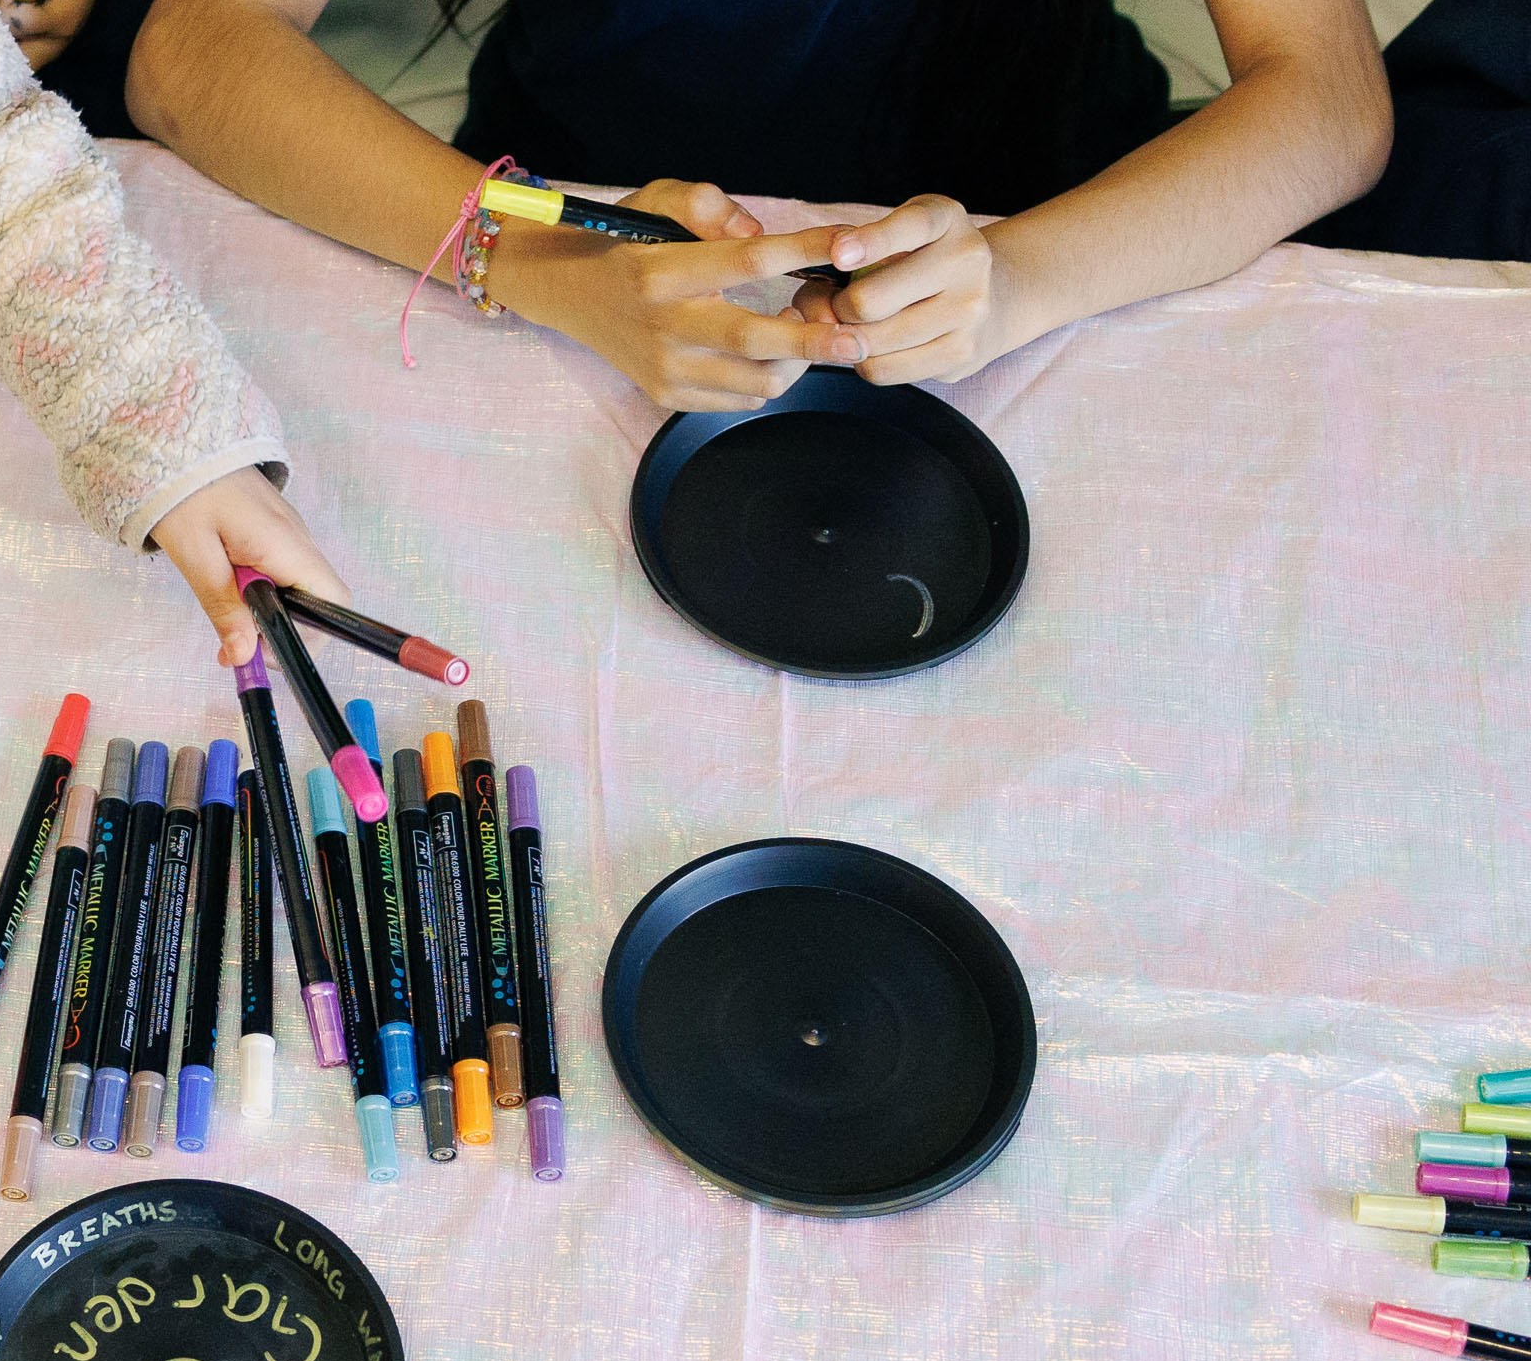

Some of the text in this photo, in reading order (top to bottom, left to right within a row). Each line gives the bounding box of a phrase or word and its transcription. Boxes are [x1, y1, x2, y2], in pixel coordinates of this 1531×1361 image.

[449, 850, 460, 877] GN.6300
[3, 817, 52, 953] METALLIC MARKER
[377, 822, 403, 959] METALLIC MARKER
[453, 878, 463, 901] COLOR
[480, 821, 508, 955] METALLIC MARKER
[174, 893, 183, 916] COLOR
[455, 901, 465, 920] YOUR
[73, 864, 106, 998] METALLIC MARKER
[172, 917, 180, 935] YOUR
[457, 921, 467, 942] DALLY
[170, 935, 178, 958] DALLY
[459, 942, 468, 956] LIFE
[31, 1201, 178, 1270] BREATHS
[274, 1221, 346, 1300] LONG
